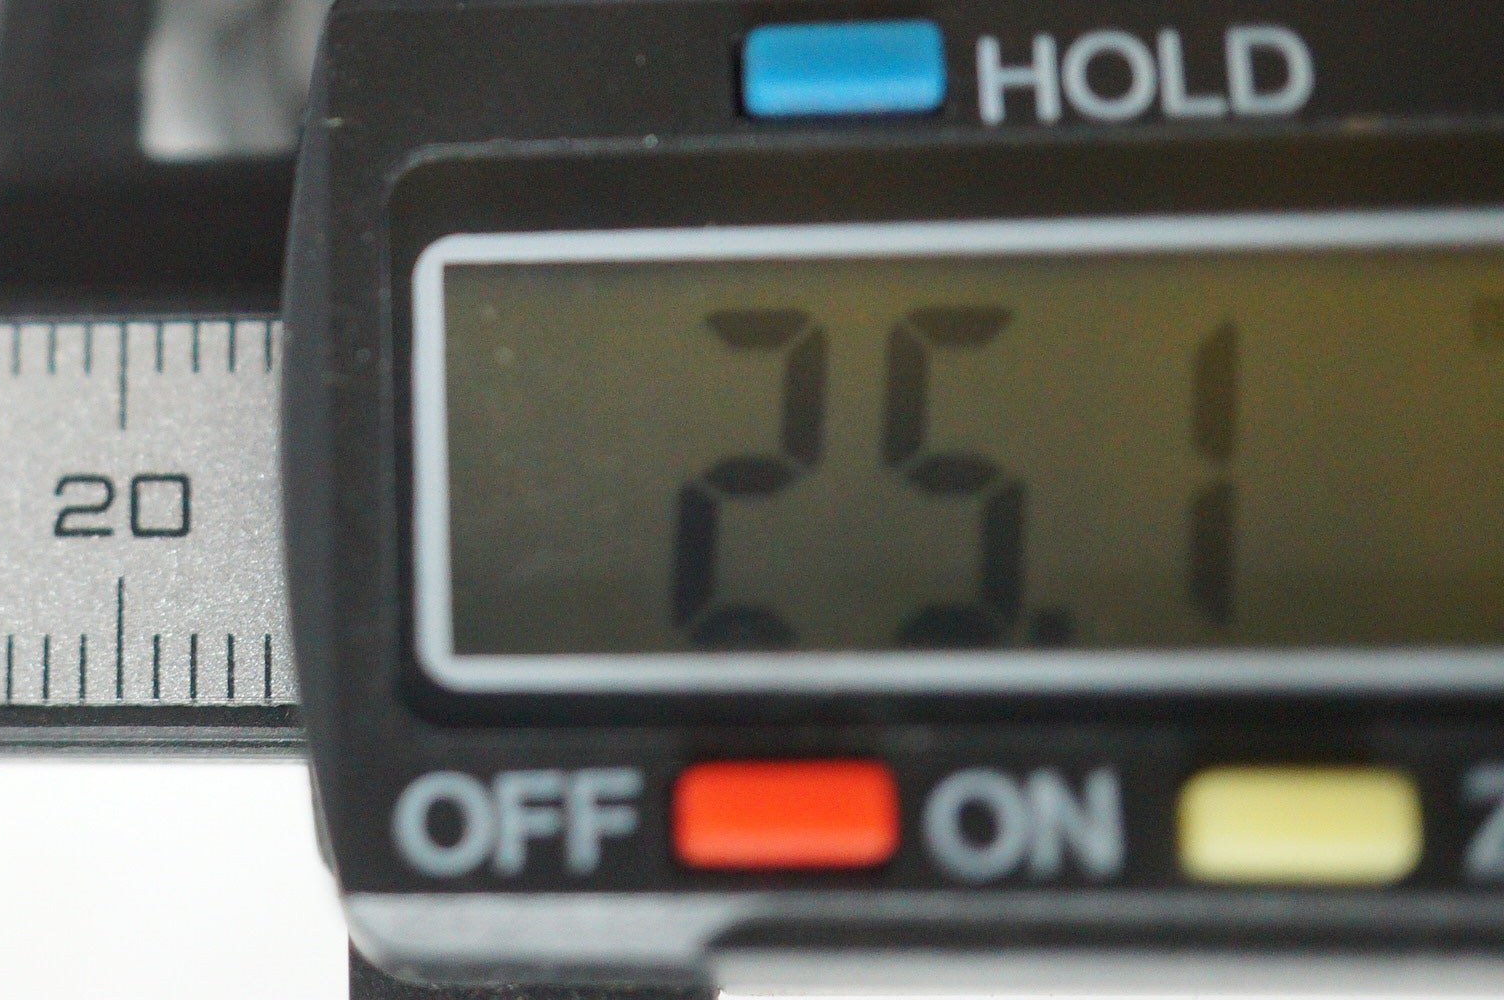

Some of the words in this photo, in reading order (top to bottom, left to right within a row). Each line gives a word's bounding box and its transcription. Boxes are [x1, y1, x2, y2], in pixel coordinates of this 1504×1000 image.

[976, 24, 1315, 125] HOLD
[53, 474, 192, 538] 20
[672, 306, 1239, 648] 25.1
[392, 768, 644, 877] OFF
[923, 768, 1126, 881] ON
